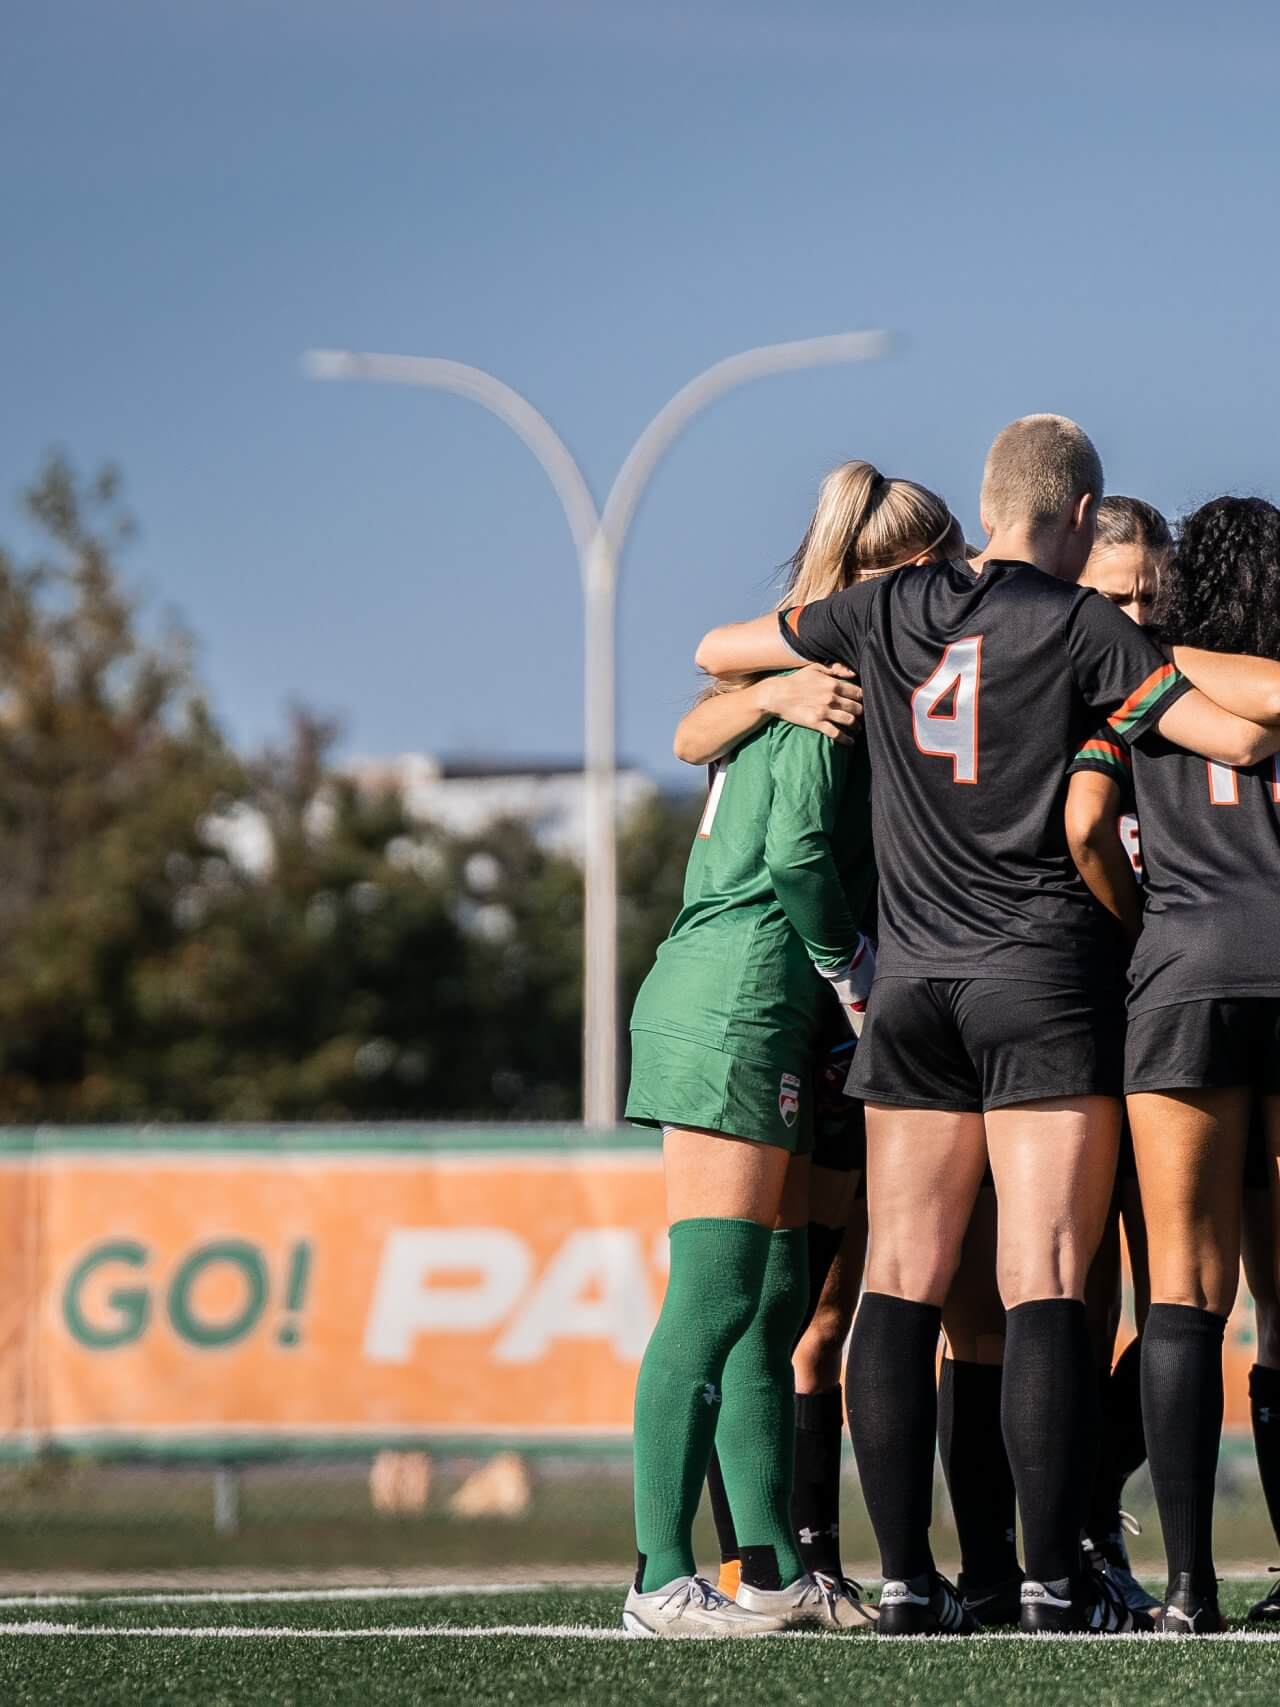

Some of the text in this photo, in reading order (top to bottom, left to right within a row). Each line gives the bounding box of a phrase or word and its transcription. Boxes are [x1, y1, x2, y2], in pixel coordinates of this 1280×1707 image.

[911, 634, 984, 785] 4
[61, 1226, 671, 1363] GO! PA
